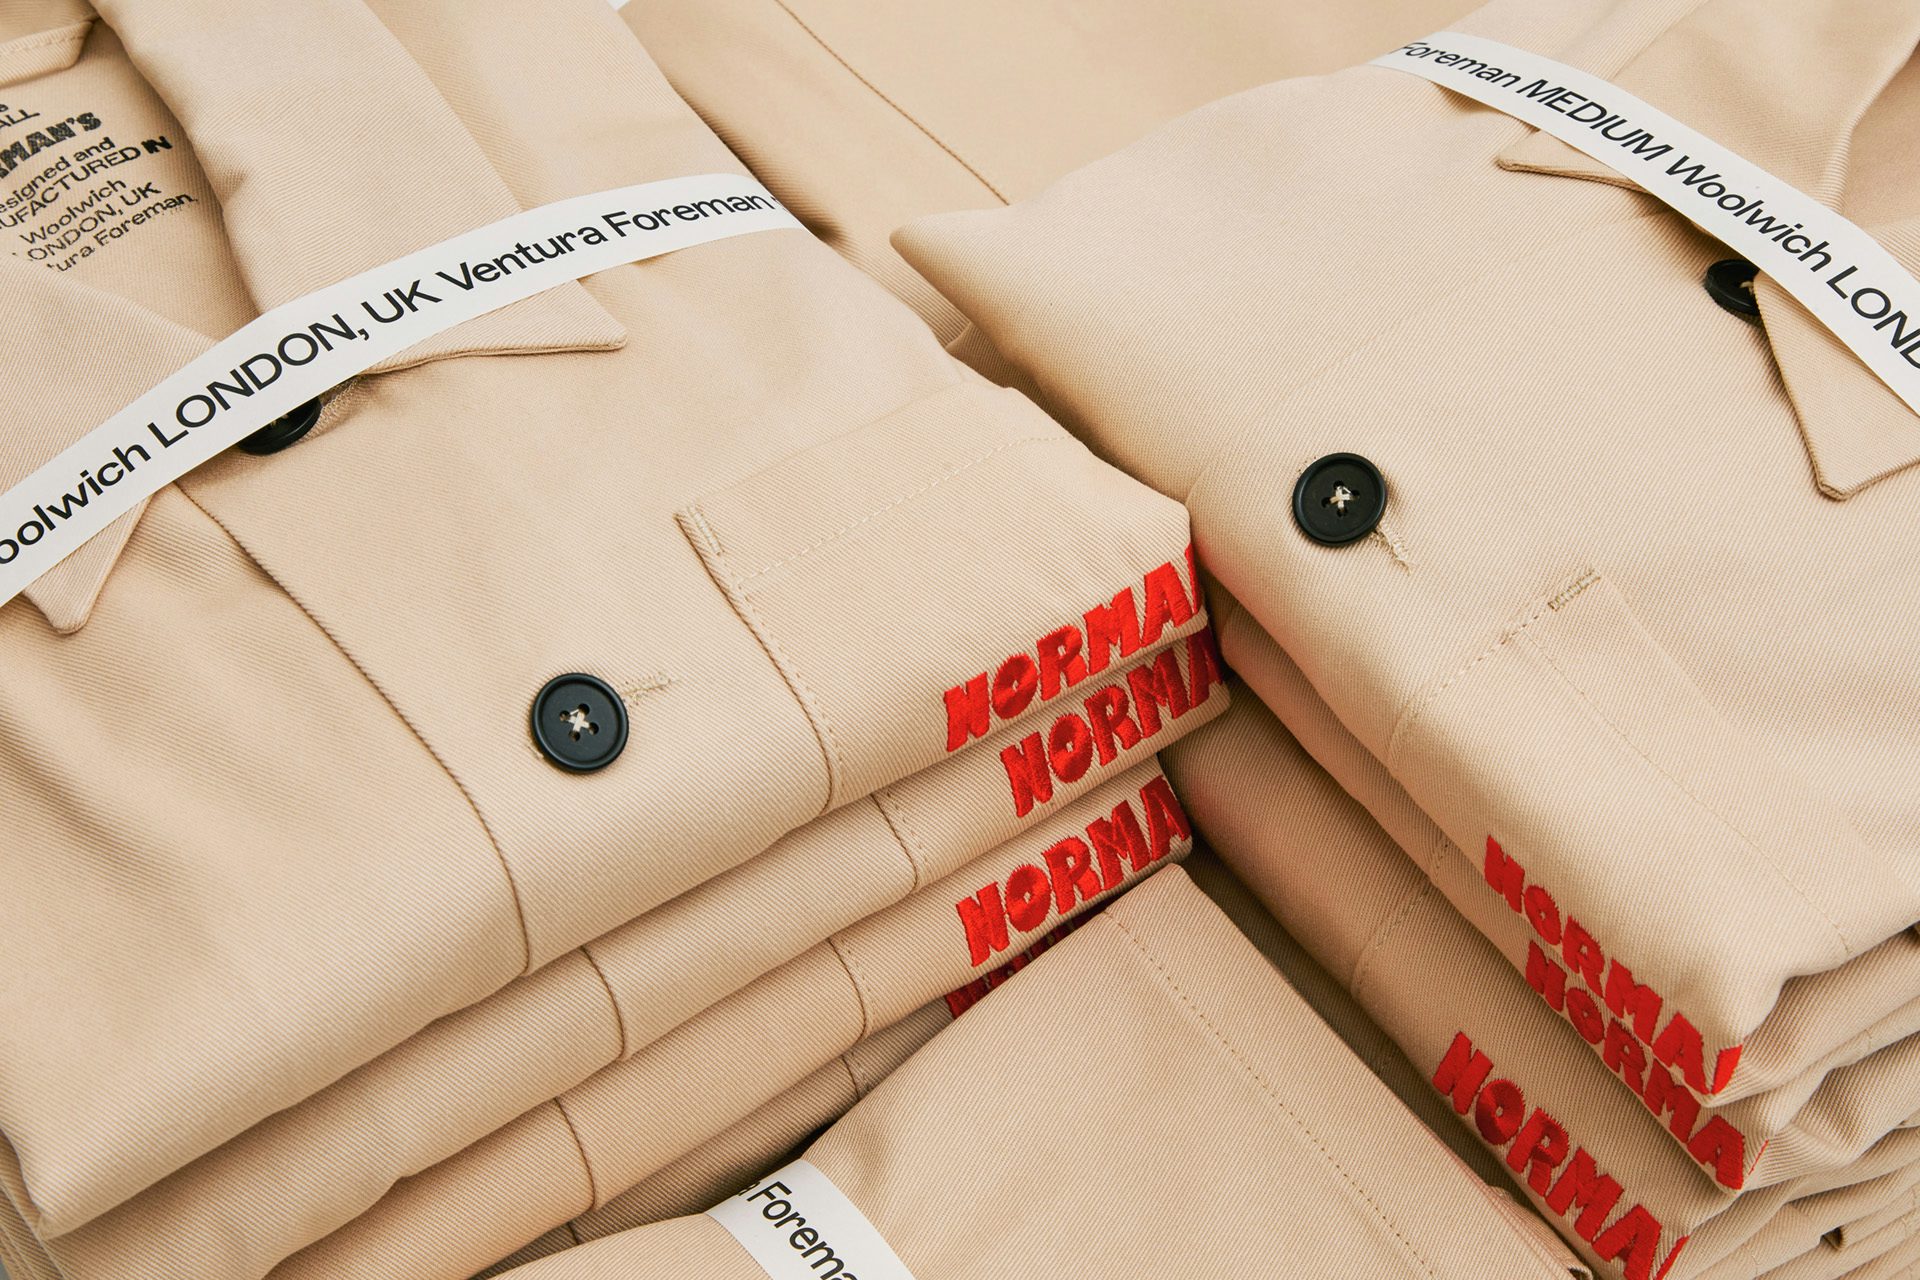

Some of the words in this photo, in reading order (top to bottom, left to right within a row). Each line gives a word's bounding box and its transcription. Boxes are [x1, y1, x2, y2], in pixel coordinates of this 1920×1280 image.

[0, 112, 101, 179] MAN'S
[0, 146, 141, 230] UFACTURED
[141, 135, 173, 155] IN
[73, 136, 116, 162] and
[1402, 41, 1521, 88] Foreman
[1516, 79, 1674, 161] MEDIUM
[1665, 155, 1832, 272] Woolwich
[12, 203, 124, 262] ONDON,
[120, 182, 161, 206] UK
[19, 180, 127, 246] Woolwich
[47, 245, 95, 273] ura
[93, 192, 192, 246] Foreman
[0, 444, 151, 564] oolwich
[147, 313, 370, 448] LONDON,
[361, 281, 443, 324] UK
[435, 226, 608, 291] Ventura
[601, 192, 776, 237] Foreman
[956, 775, 1190, 967] NORMA
[1525, 940, 1769, 1190] NORMA
[1432, 1031, 1689, 1280] NORMA
